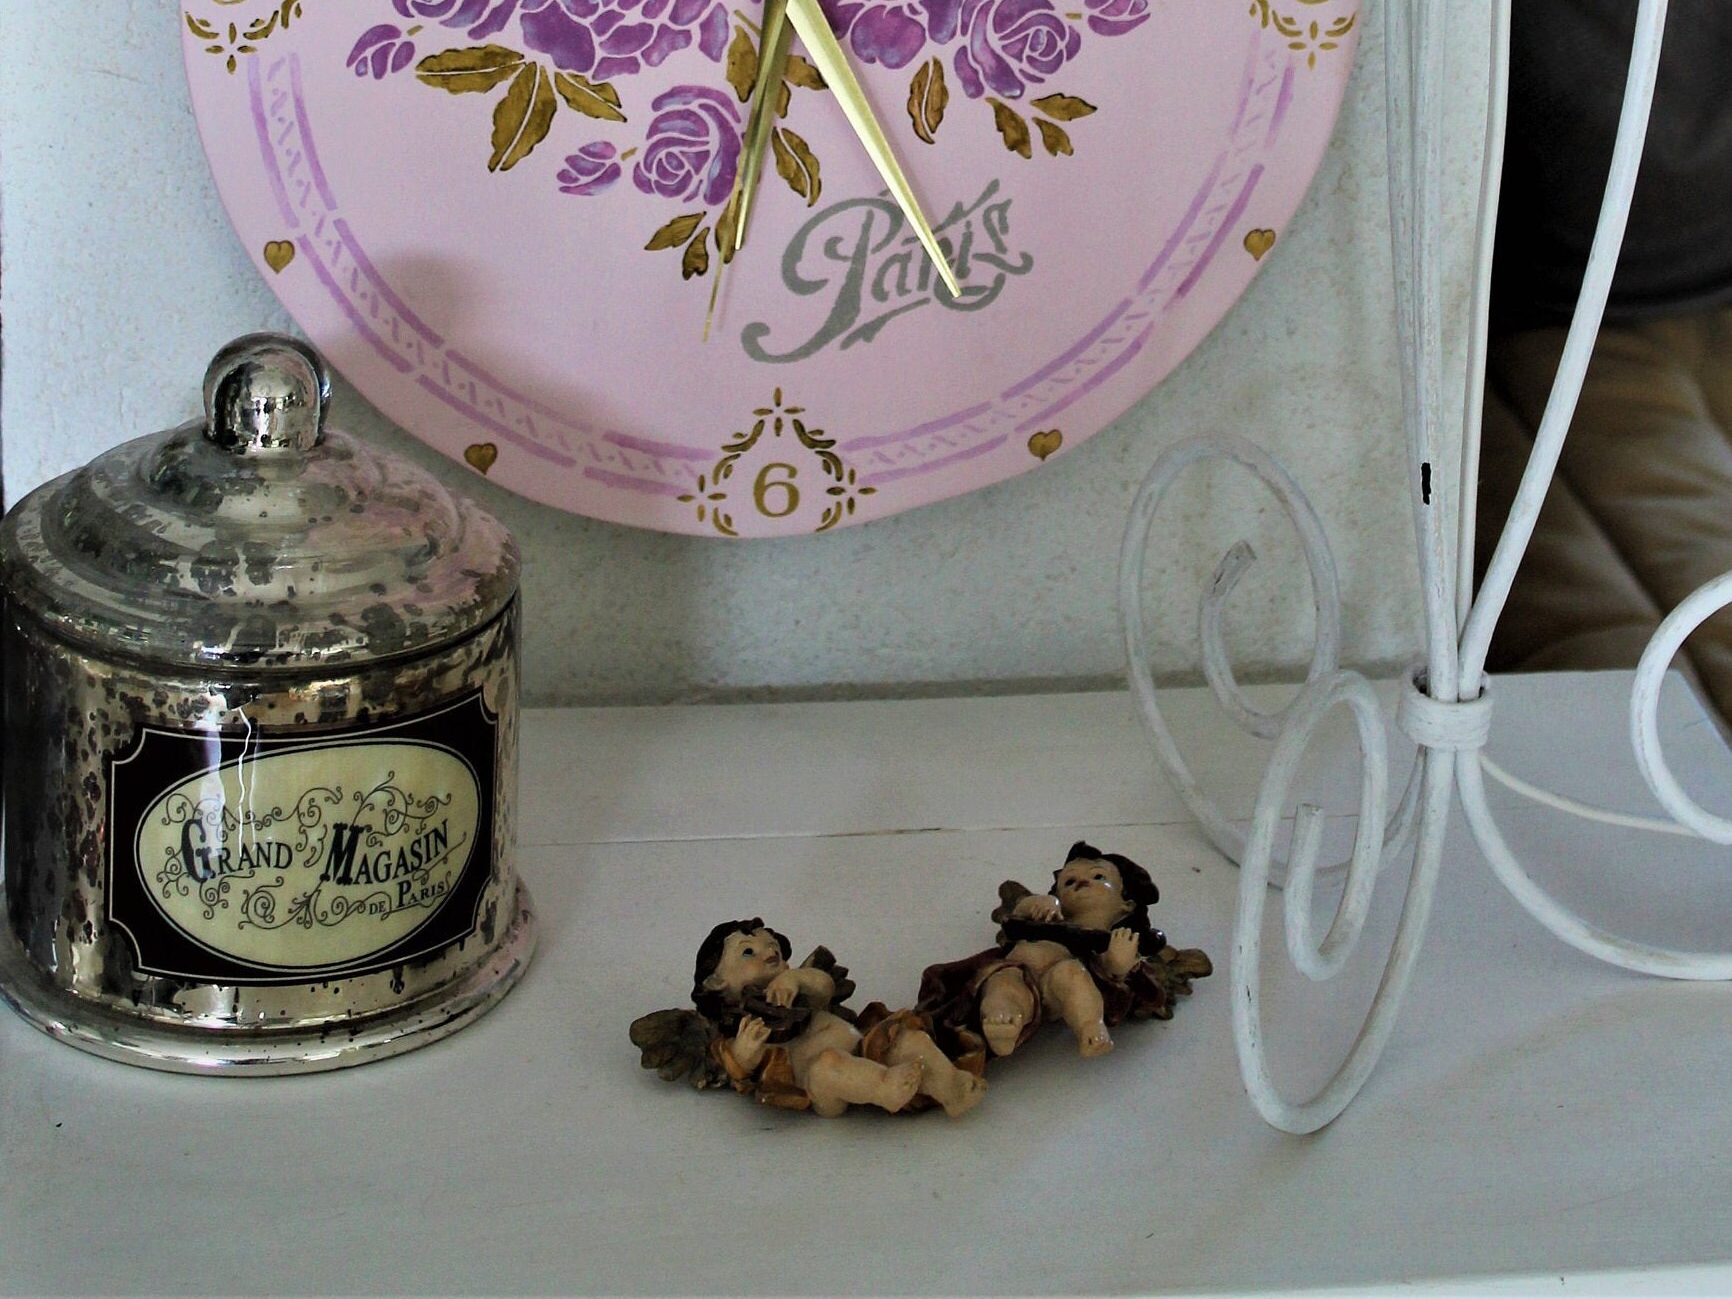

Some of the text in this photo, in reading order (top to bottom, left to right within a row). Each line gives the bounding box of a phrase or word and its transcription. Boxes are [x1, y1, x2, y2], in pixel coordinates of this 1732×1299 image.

[753, 462, 799, 518] 6
[181, 818, 450, 887] GRAND MAGASIN
[396, 879, 446, 909] PARIS
